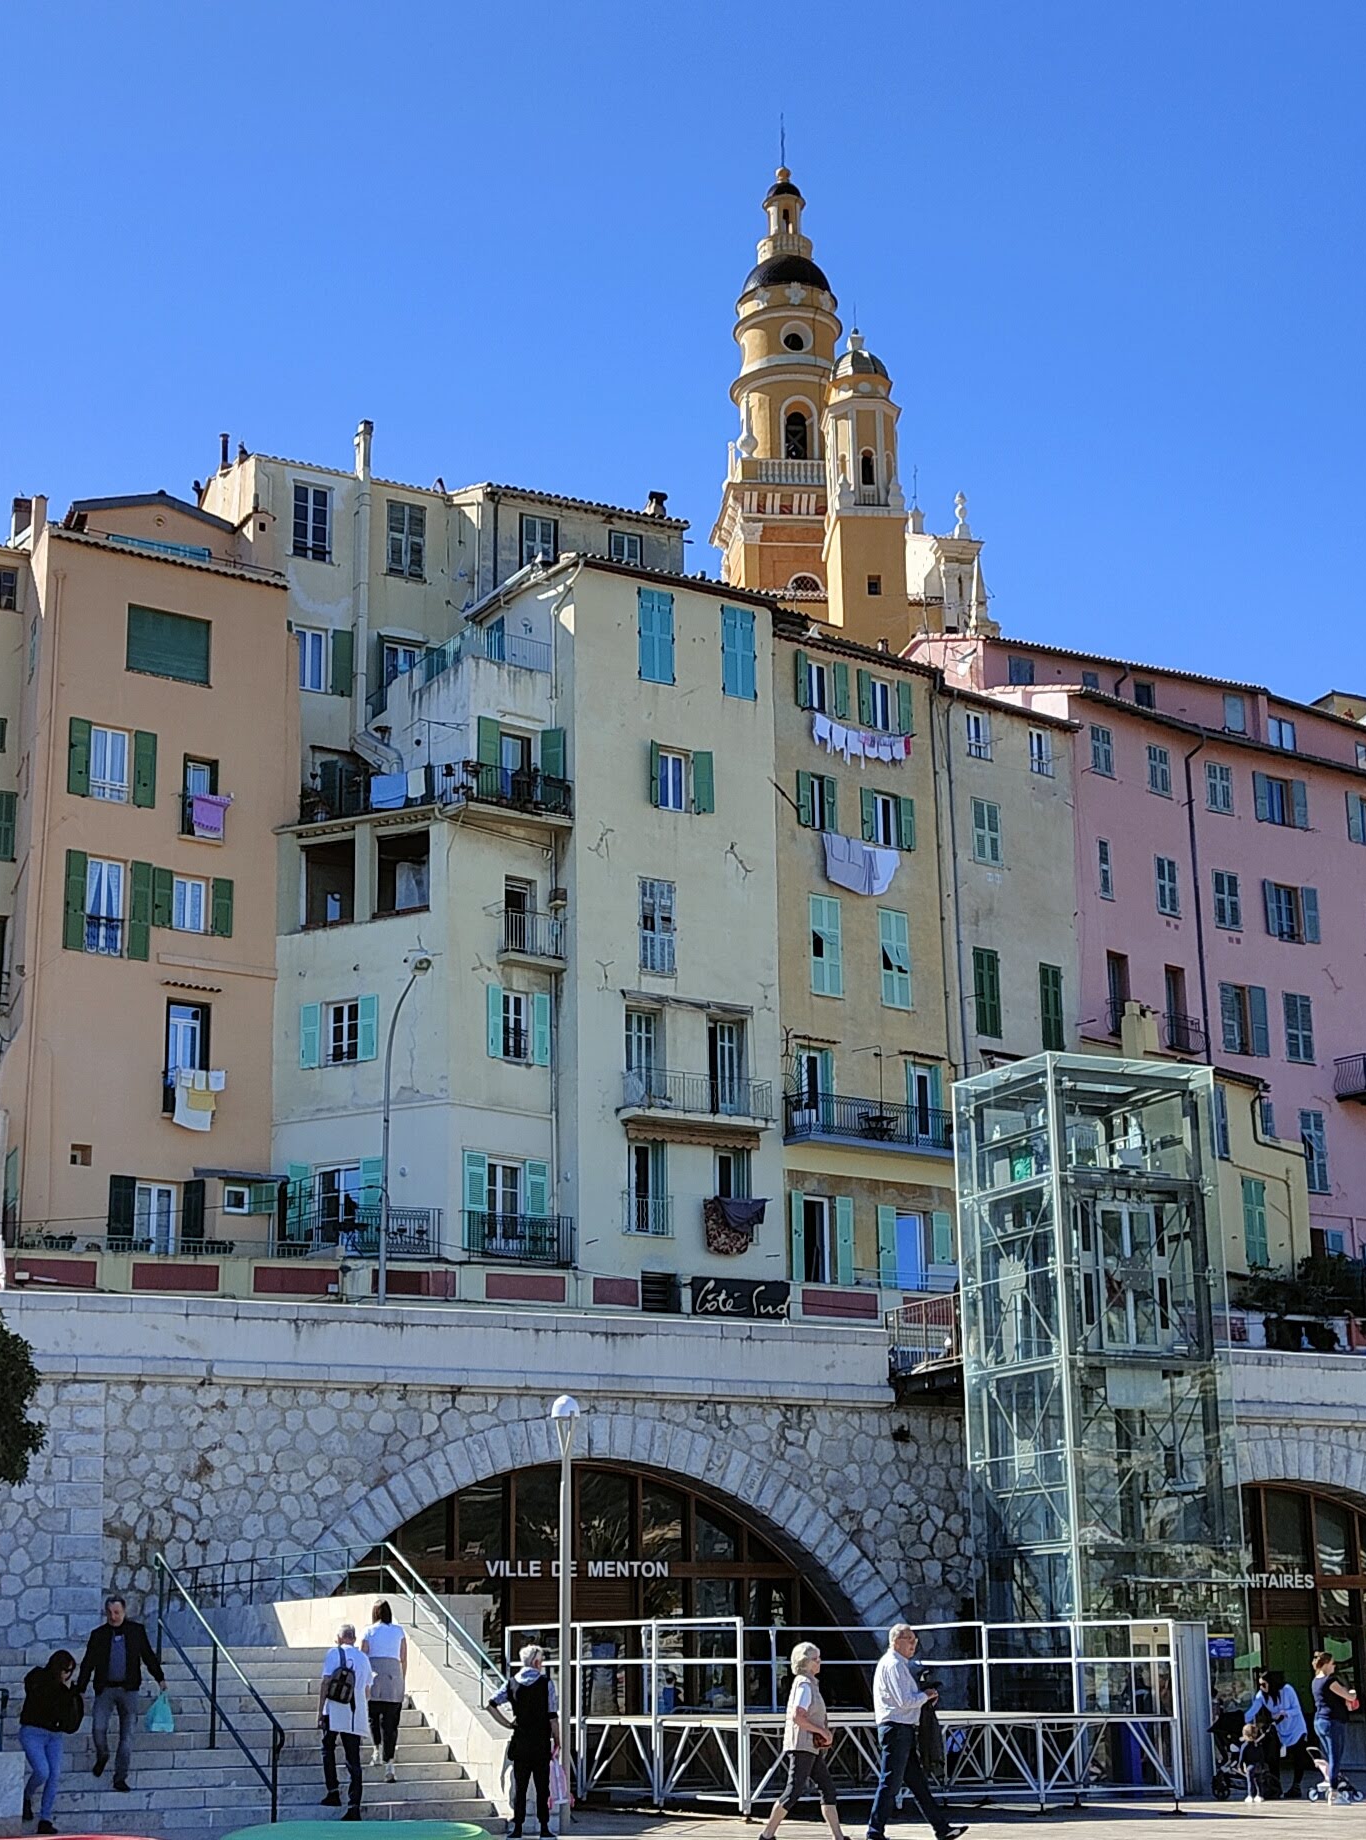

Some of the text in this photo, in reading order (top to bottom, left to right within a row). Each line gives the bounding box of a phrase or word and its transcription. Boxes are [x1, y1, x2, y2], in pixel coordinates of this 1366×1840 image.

[752, 1285, 791, 1317] Sud
[485, 1560, 669, 1578] VILLE DE MENTON
